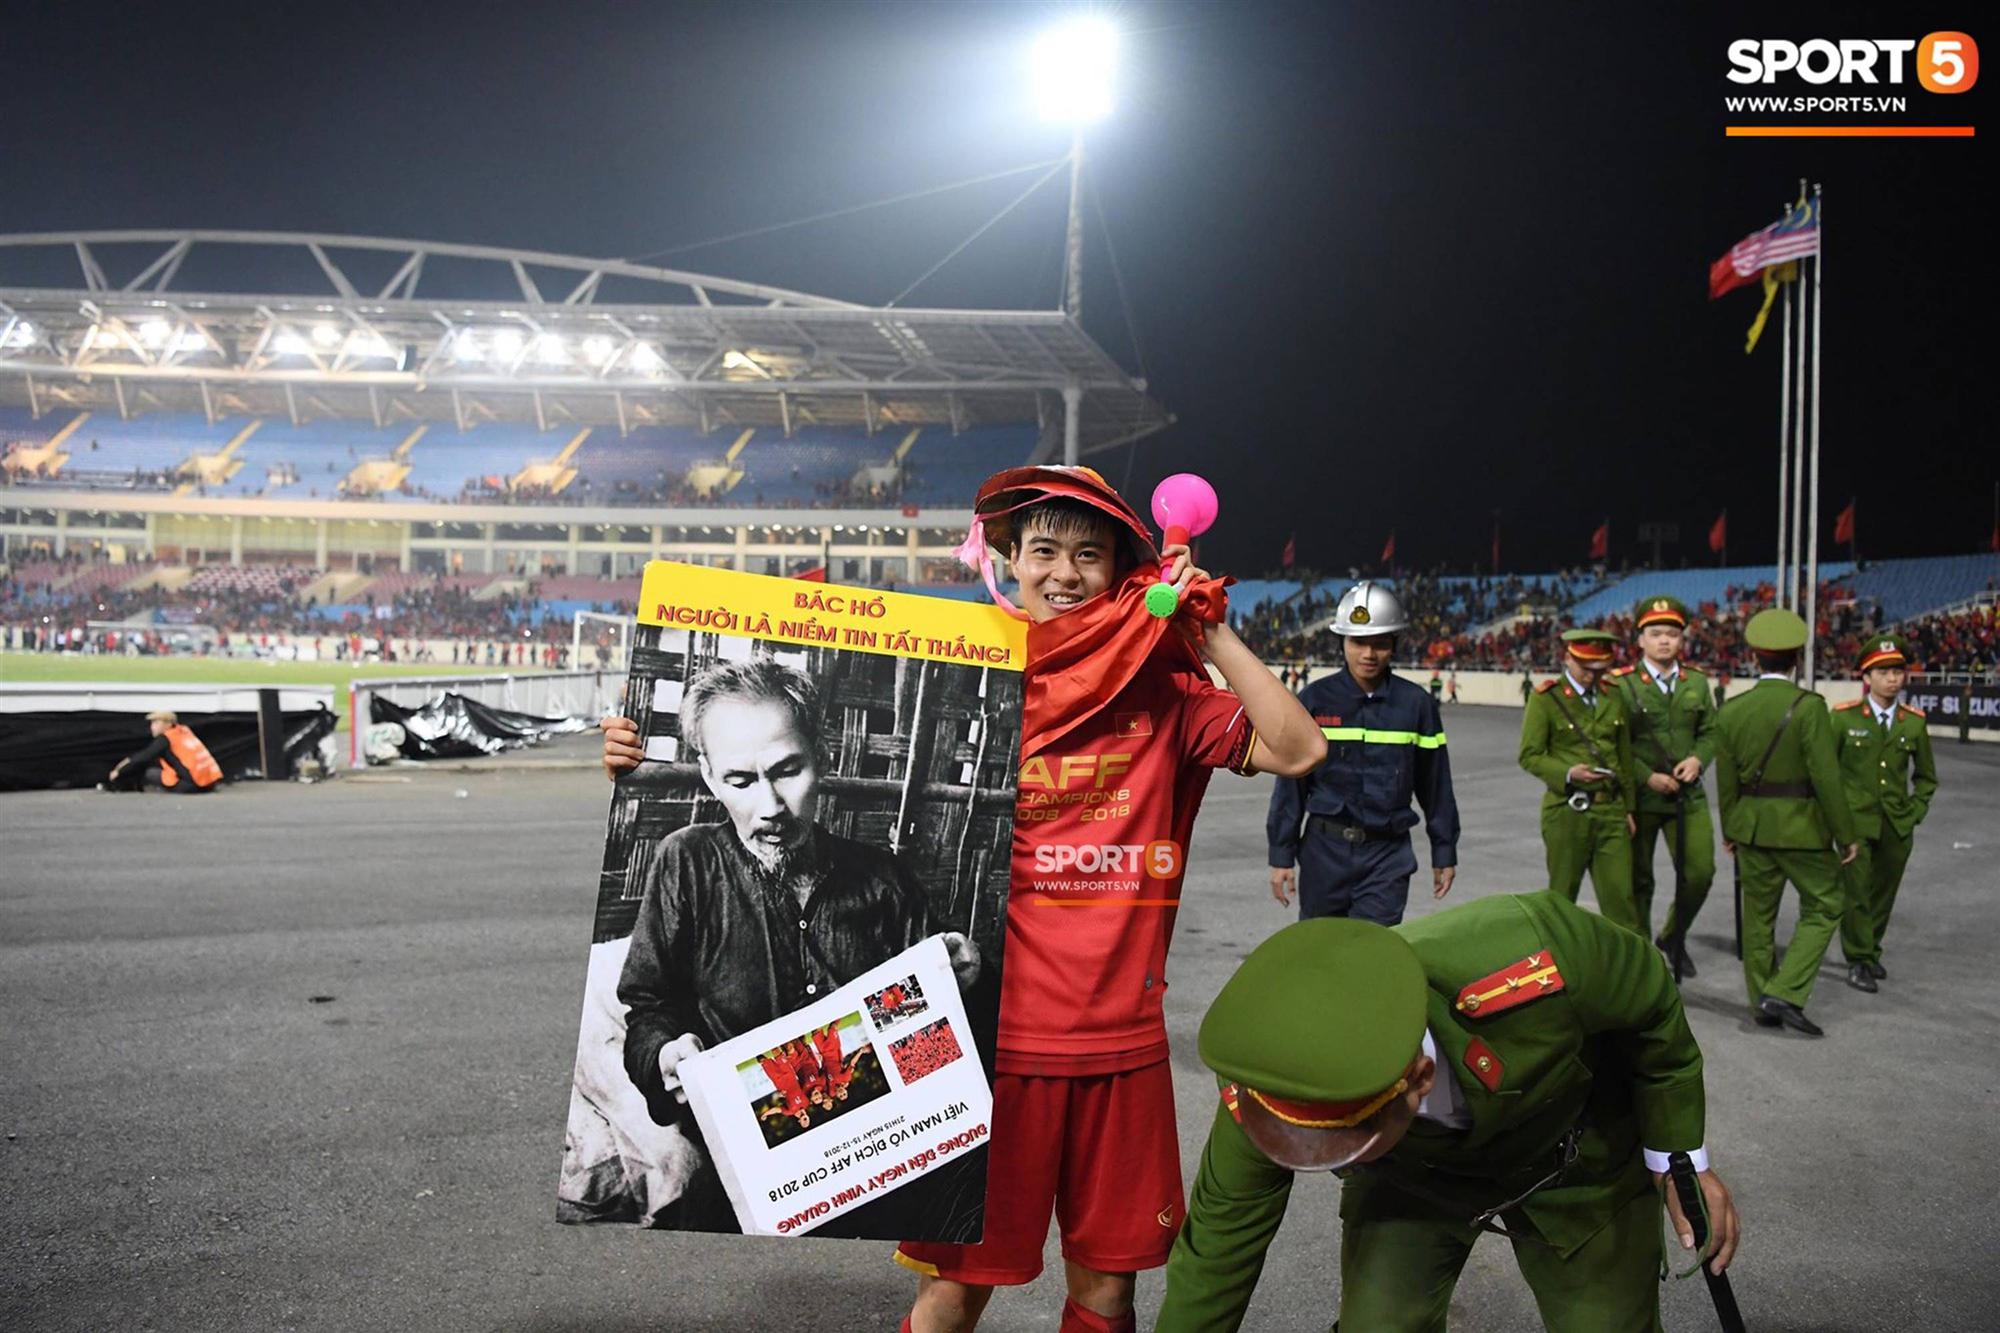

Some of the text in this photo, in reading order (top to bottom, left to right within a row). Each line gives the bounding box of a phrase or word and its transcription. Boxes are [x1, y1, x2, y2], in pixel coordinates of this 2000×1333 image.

[794, 590, 886, 618] BÁC HỒ
[656, 604, 1010, 664] NGƯỜI LÀ NIỀM TIN TẤT THẮNG!
[1018, 753, 1132, 790] AFF
[1020, 789, 1130, 805] HAMPIONS
[1017, 804, 1130, 821] 008 2018
[943, 1101, 969, 1121] VIỆT
[911, 1113, 942, 1135] NAM
[824, 1138, 861, 1158] 15-12-2018
[854, 1139, 887, 1162] ĐỊCH
[830, 1155, 851, 1174] AFF
[777, 1123, 988, 1234] ĐƯỜNG ĐẾN NGÀY VINH QUANG
[802, 1167, 827, 1187] CUP
[768, 1180, 799, 1202] 2018
